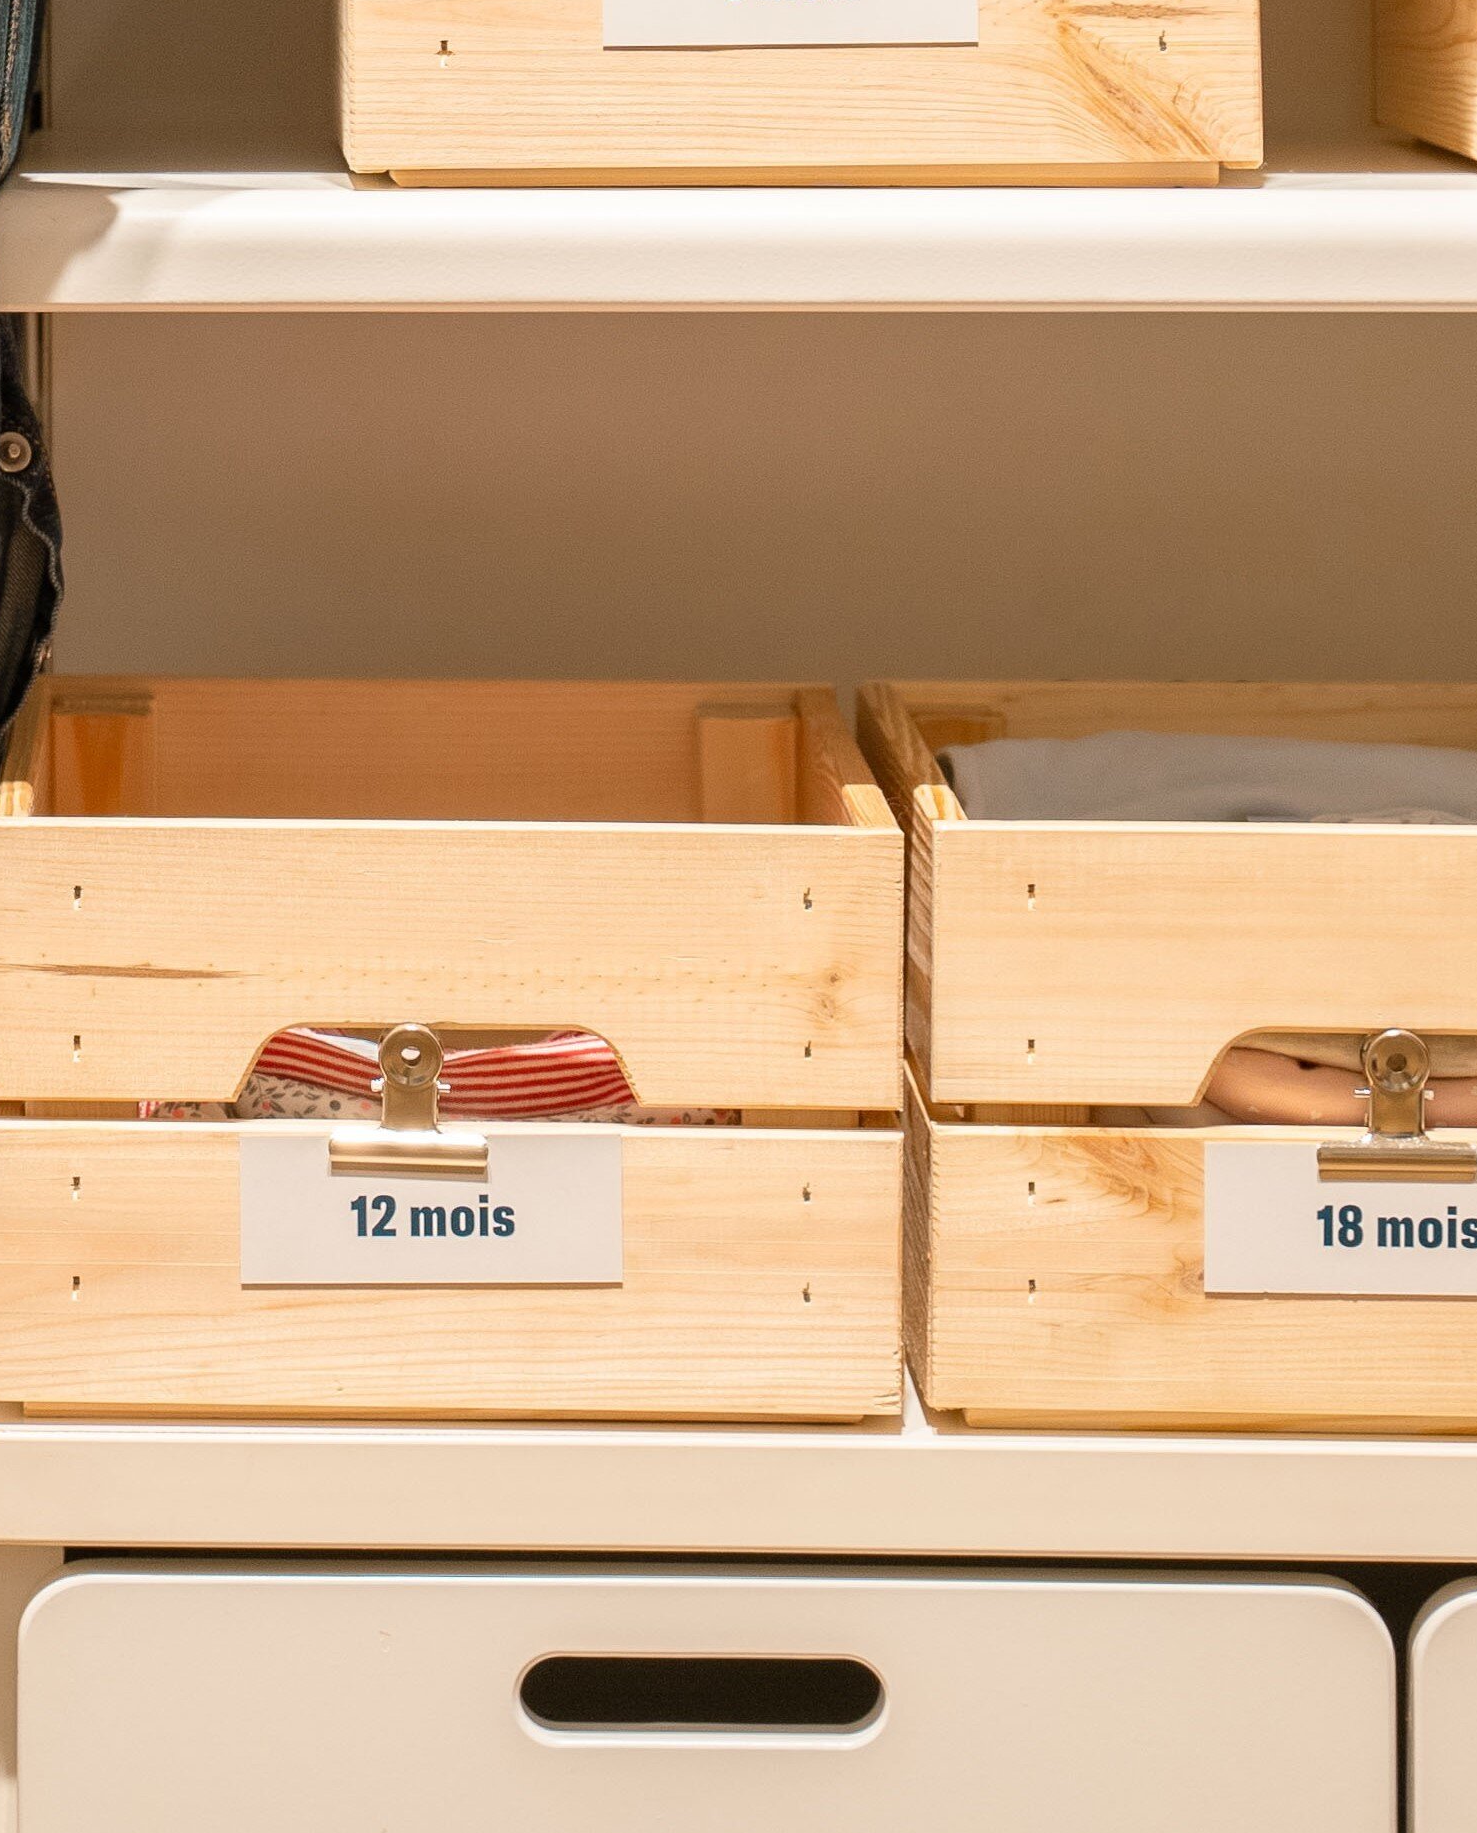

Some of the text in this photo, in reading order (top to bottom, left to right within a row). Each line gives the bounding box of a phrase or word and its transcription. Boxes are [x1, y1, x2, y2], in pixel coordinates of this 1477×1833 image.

[350, 1194, 515, 1238] 12 mois
[1317, 1205, 1364, 1248] 18
